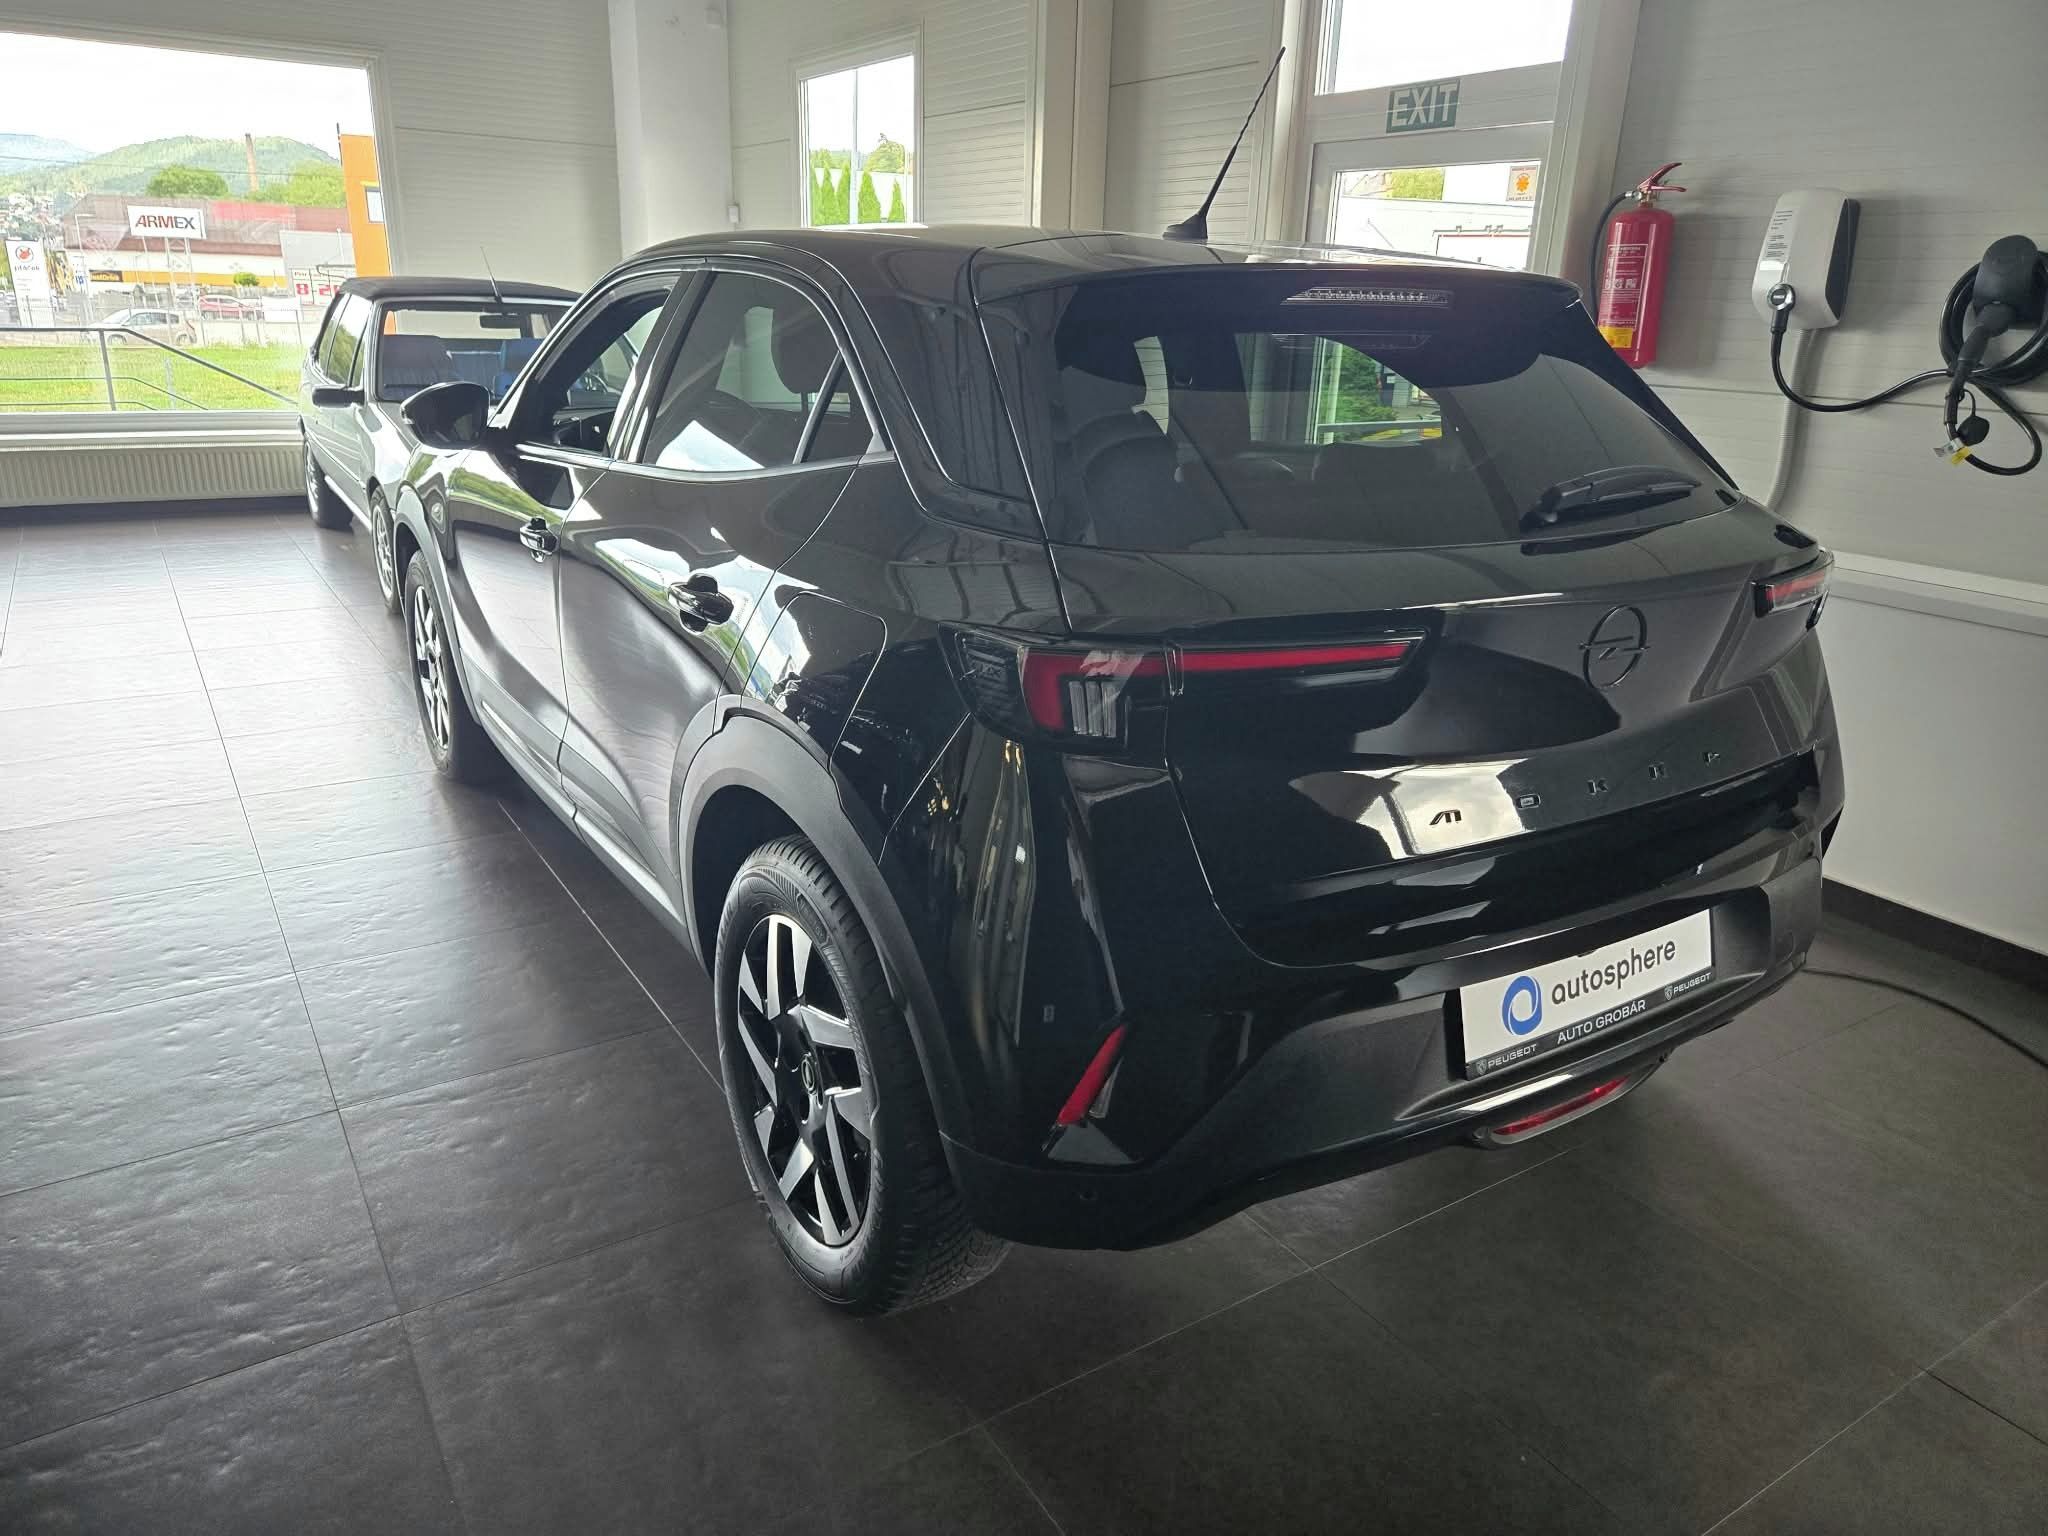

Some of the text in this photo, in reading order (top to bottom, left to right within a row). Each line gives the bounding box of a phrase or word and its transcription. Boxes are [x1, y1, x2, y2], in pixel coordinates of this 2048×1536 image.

[1392, 83, 1457, 127] EXIT
[135, 214, 196, 230] ARMEX
[1552, 940, 1676, 1005] autosphere
[1673, 972, 1712, 995] PEUGEOT
[1557, 999, 1647, 1045] AUTO GROBÁR
[1487, 1043, 1537, 1069] PEUGEOT
